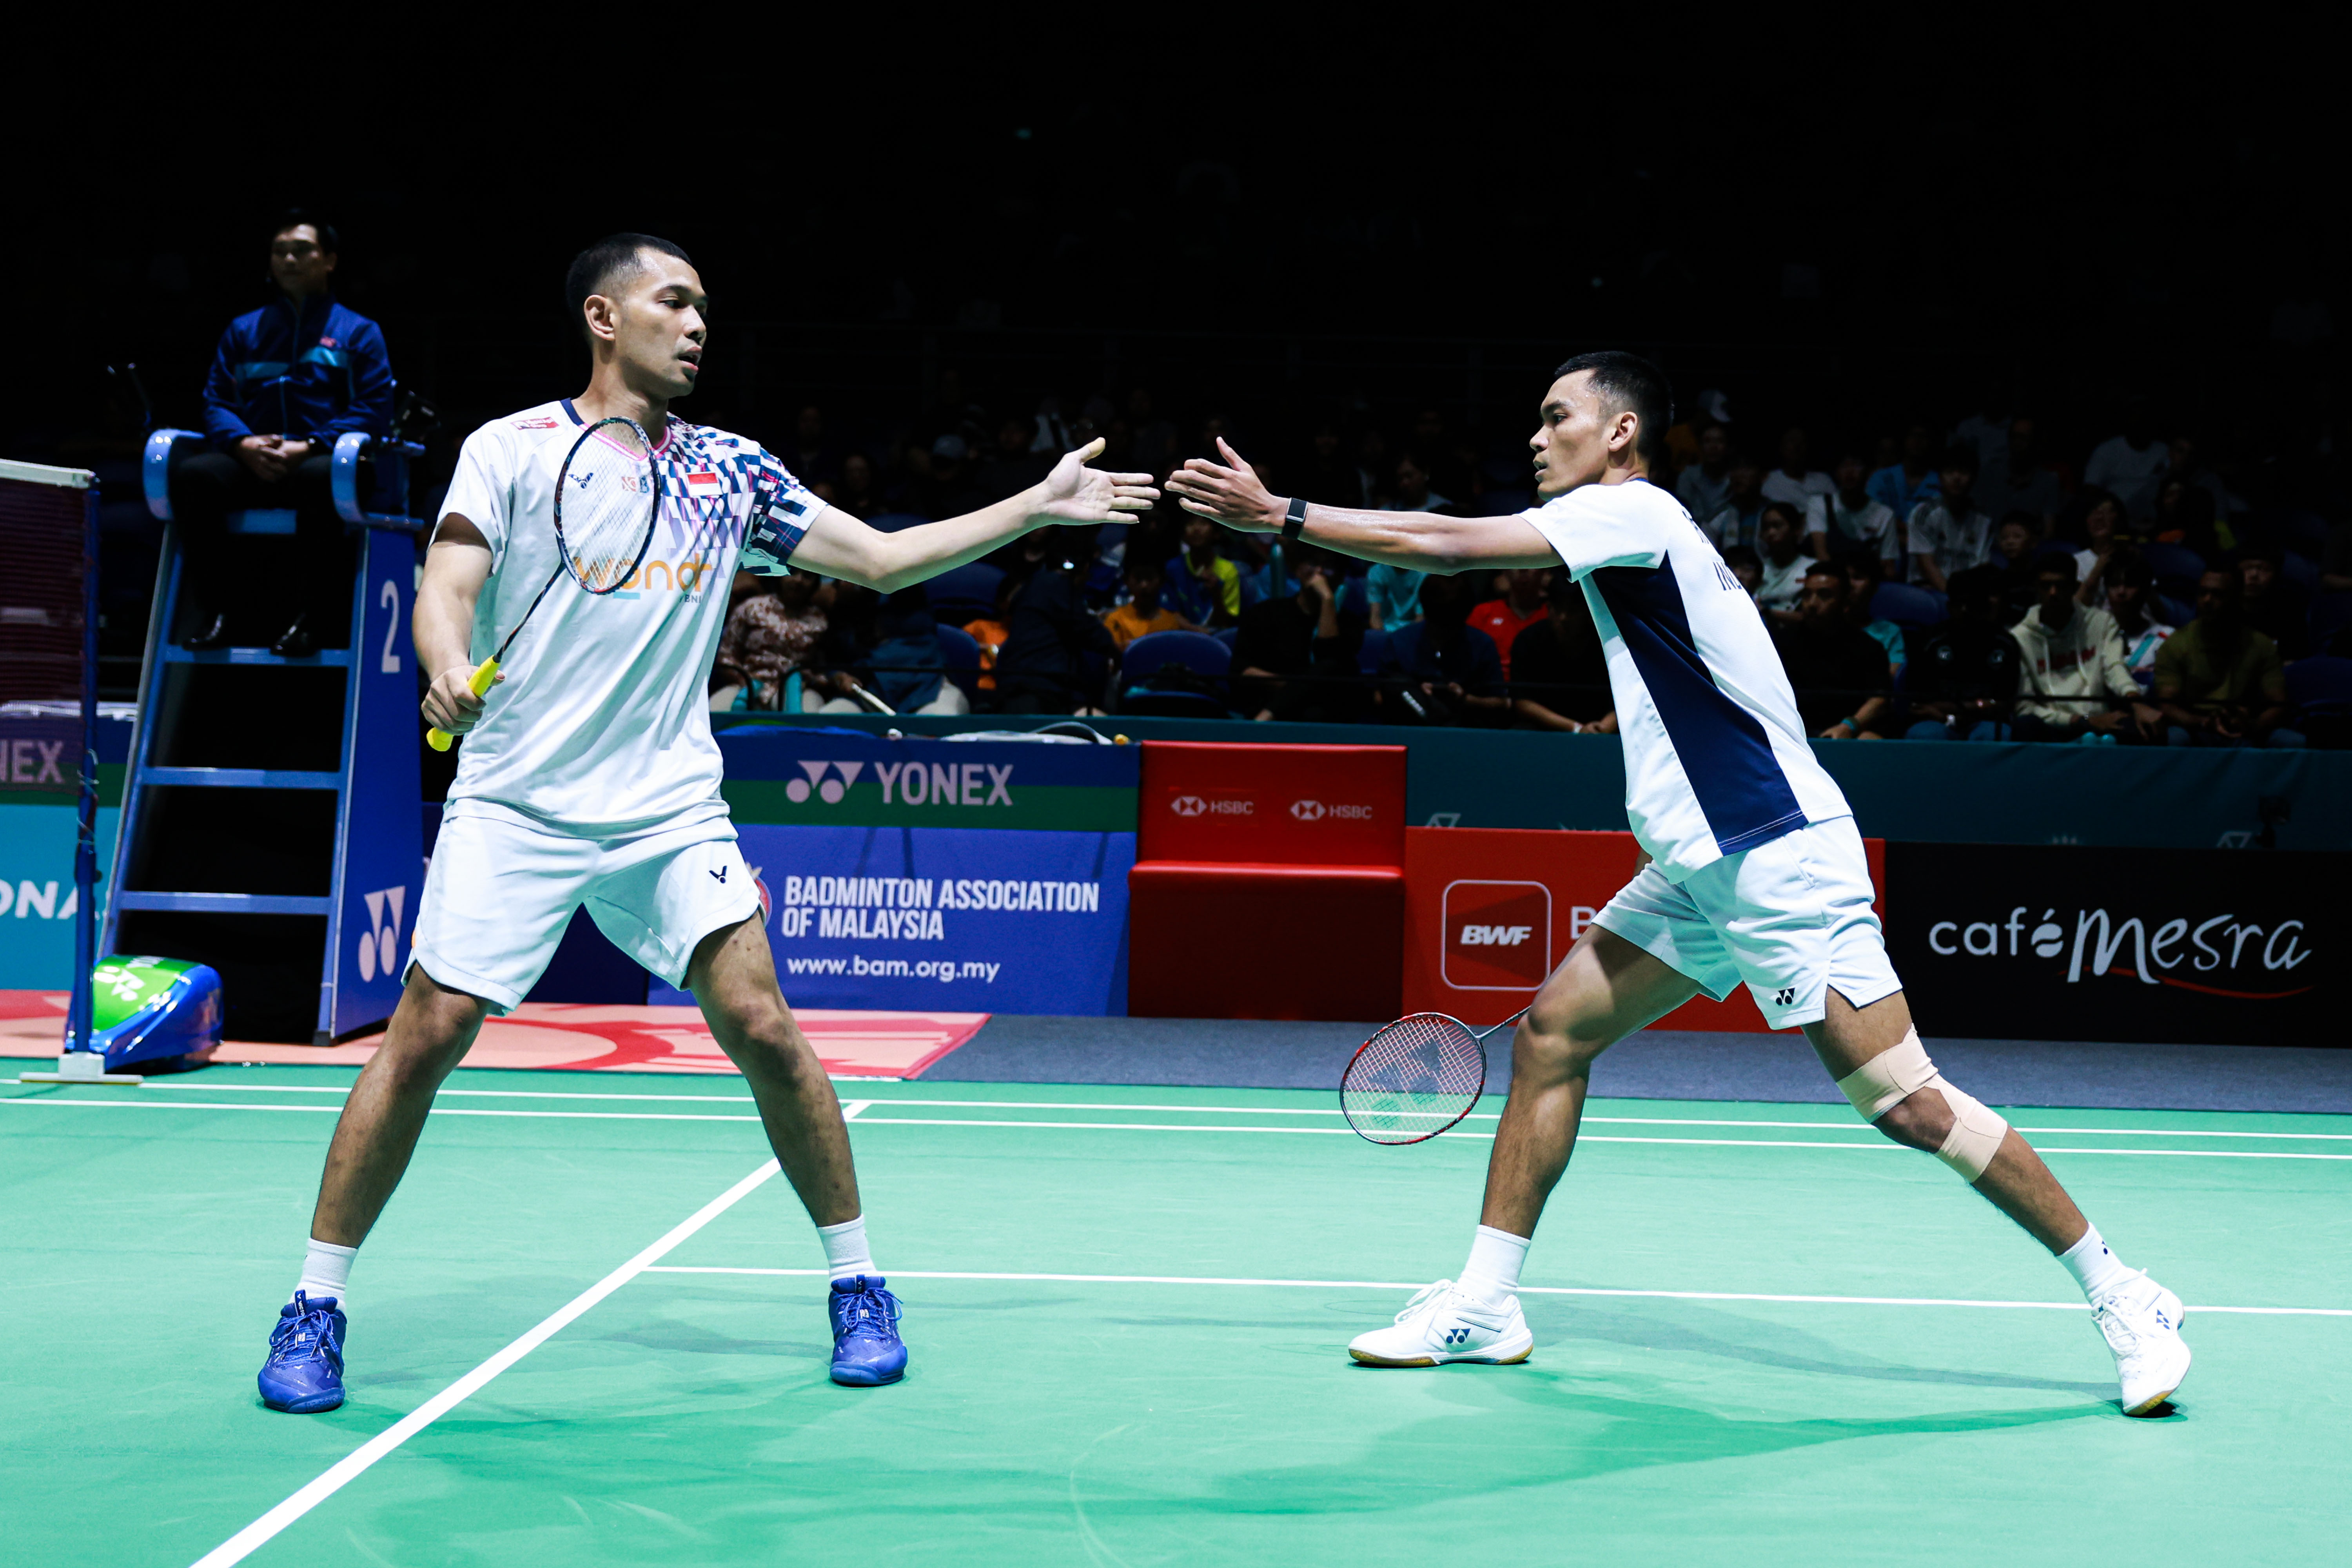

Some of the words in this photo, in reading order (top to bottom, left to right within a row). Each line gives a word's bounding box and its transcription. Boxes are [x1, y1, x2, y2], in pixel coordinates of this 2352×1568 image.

[380, 579, 401, 673] 2
[0, 739, 65, 783] EX
[873, 761, 1014, 807] YONEX
[1210, 800, 1254, 815] HSBC
[1328, 804, 1372, 820] HSBC
[786, 876, 933, 908] BADMINTON
[938, 879, 1099, 912] ASSOCIATION
[782, 907, 815, 938] OF
[818, 908, 944, 940] MALAYSIA
[1460, 924, 1533, 946] BWF
[787, 955, 1000, 983] www.bam.org.my
